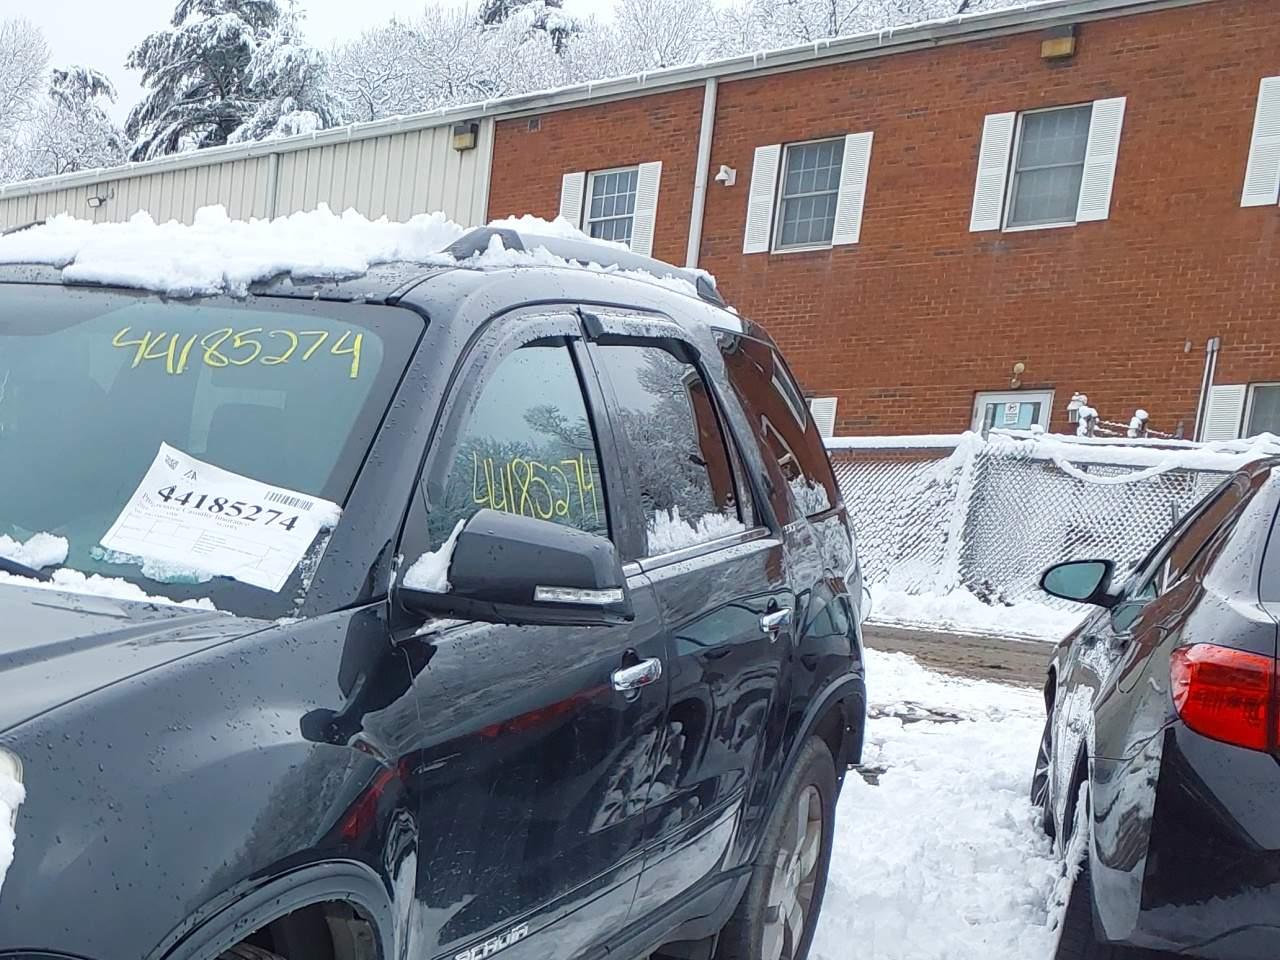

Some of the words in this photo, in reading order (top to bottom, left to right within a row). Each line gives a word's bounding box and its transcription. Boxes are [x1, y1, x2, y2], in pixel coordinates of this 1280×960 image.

[111, 326, 364, 379] 44185274
[157, 483, 300, 532] 44185274
[472, 450, 599, 521] 44185274
